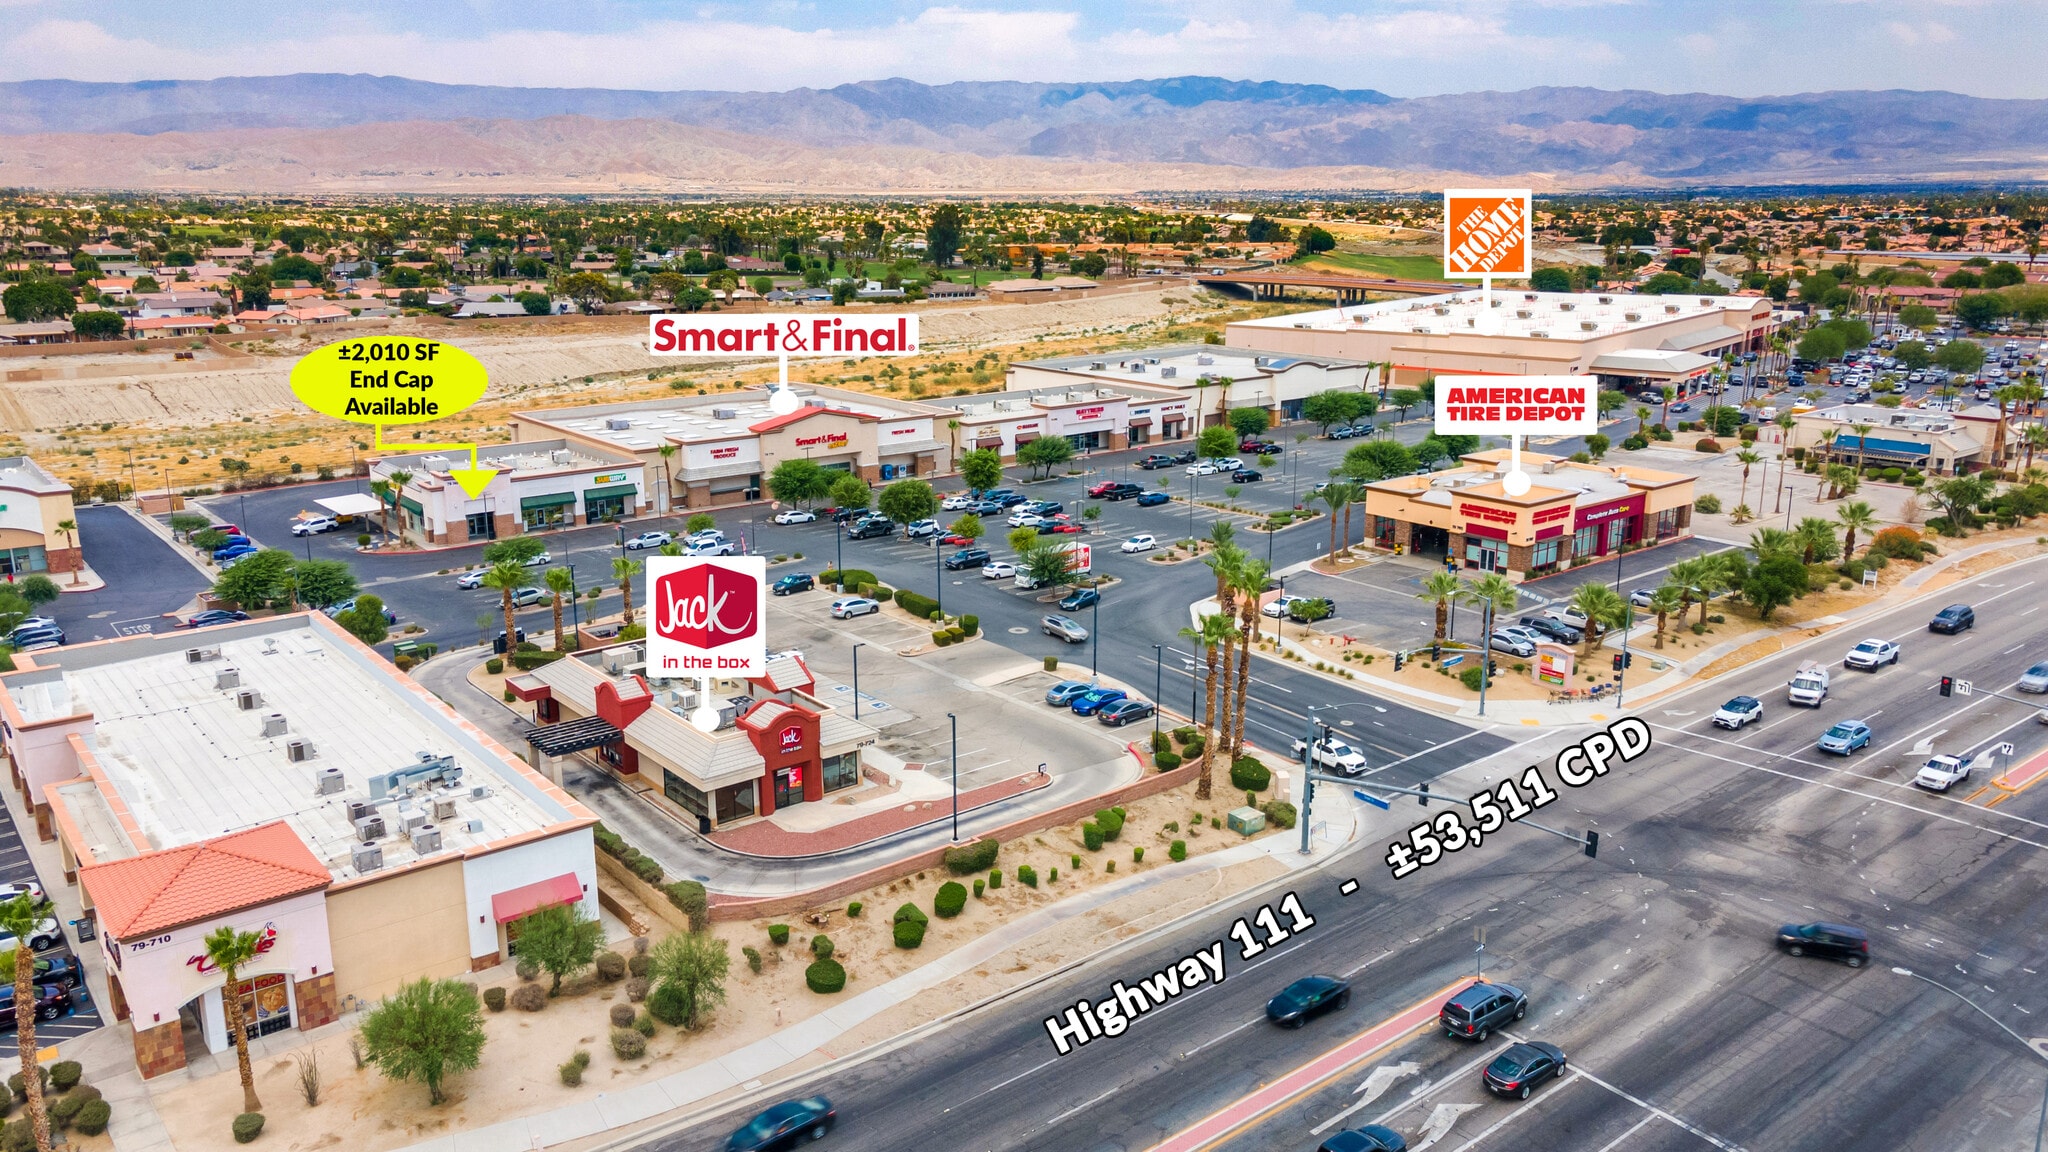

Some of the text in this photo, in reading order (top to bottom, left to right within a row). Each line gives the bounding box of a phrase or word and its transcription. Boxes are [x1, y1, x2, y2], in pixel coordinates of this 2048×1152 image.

[122, 623, 152, 636] STOP
[781, 729, 802, 746] Jack
[131, 934, 172, 952] 79-710
